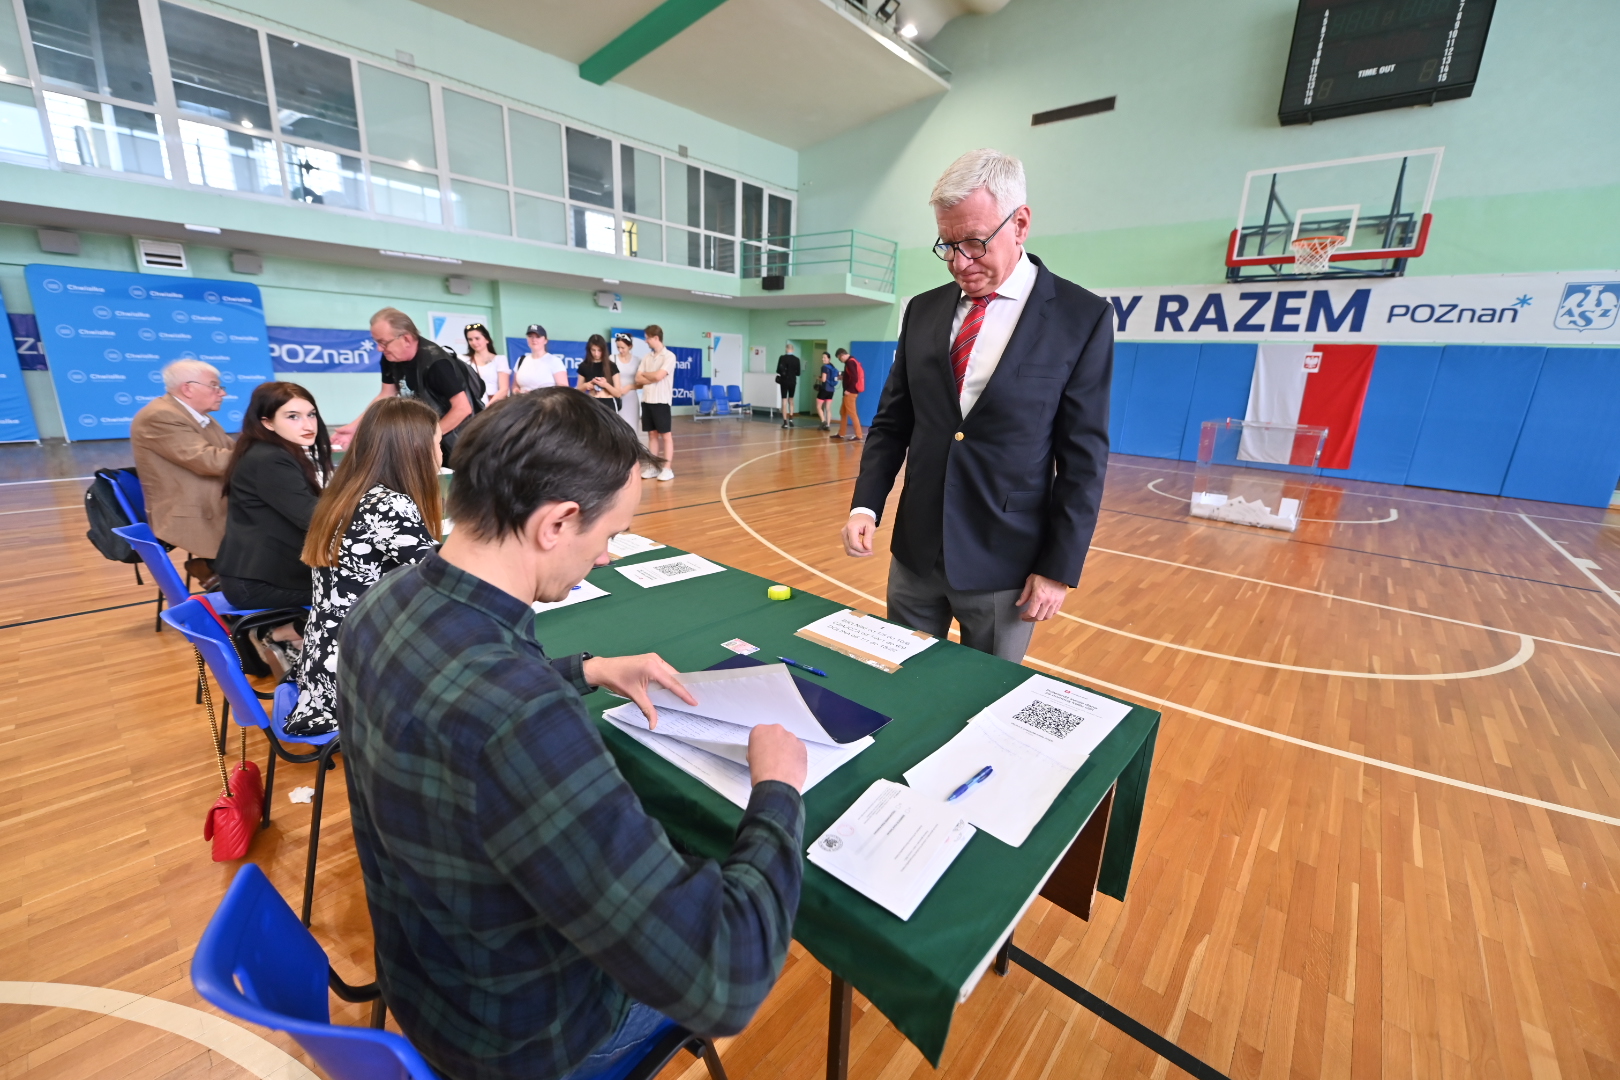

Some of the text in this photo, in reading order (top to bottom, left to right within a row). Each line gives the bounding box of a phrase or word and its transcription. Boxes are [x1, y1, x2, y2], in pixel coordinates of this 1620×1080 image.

[1448, 30, 1459, 39] 10
[1446, 39, 1455, 48] 11
[1444, 47, 1454, 56] 12
[1442, 56, 1452, 65] 13
[1357, 63, 1396, 78] TIME OUT
[1440, 65, 1449, 73] 14
[1438, 73, 1448, 82] 15
[612, 302, 619, 311] A
[1100, 289, 1372, 332] Y RAZEM
